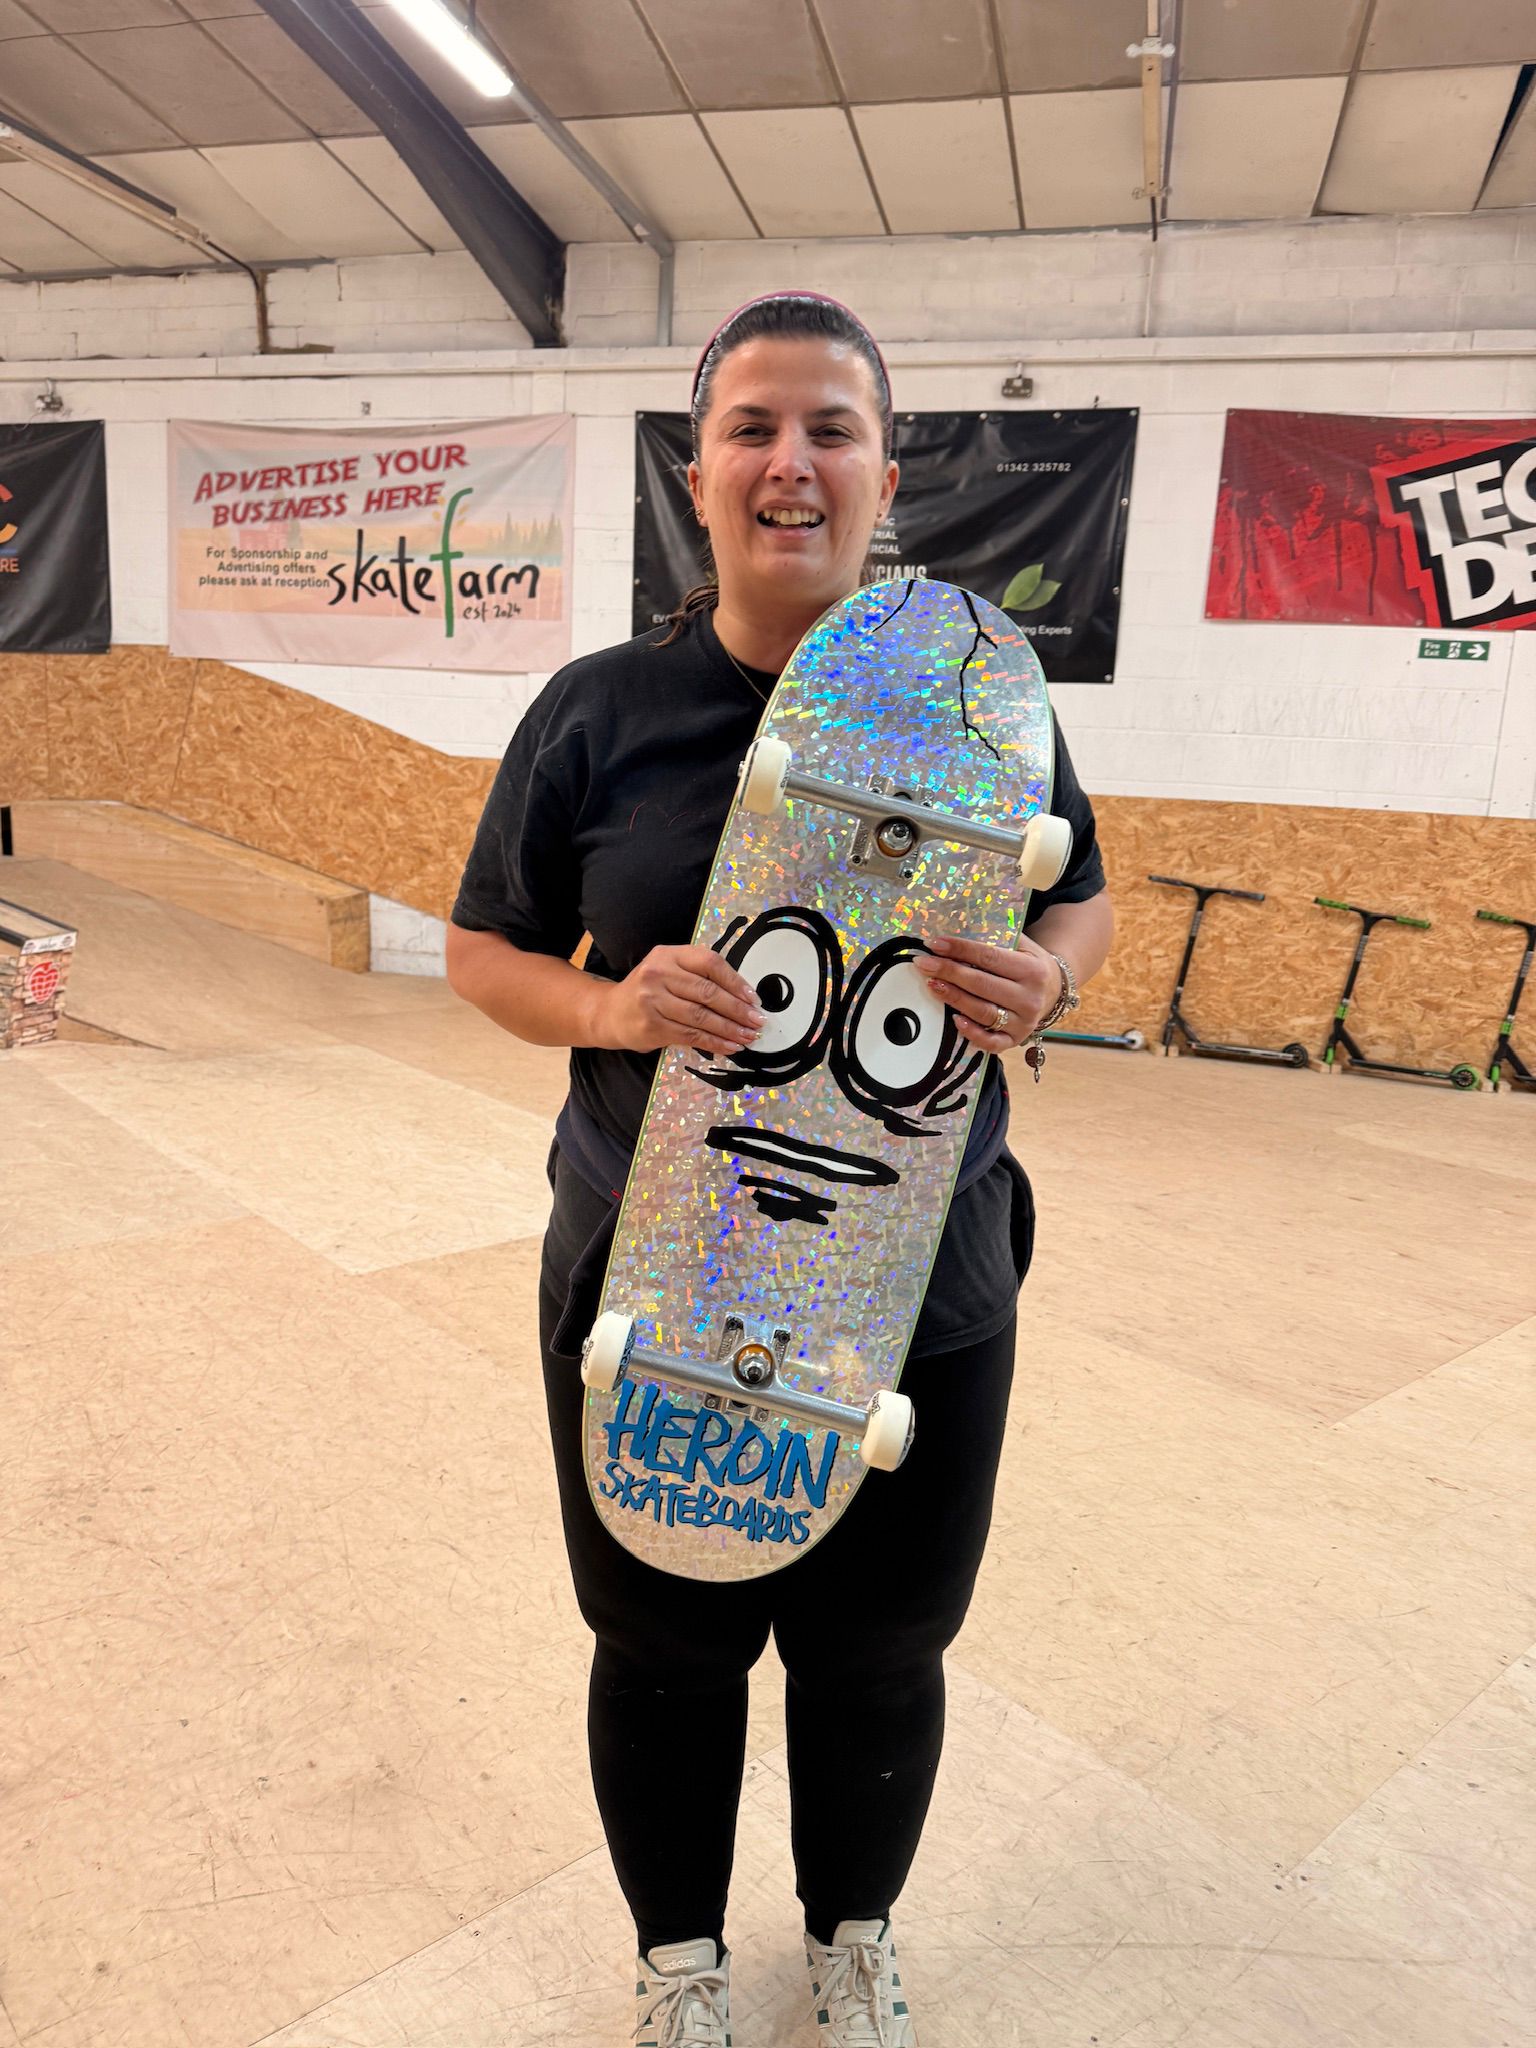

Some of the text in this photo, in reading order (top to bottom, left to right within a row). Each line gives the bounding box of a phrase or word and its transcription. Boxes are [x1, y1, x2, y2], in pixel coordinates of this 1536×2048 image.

[194, 443, 469, 504] ADVERTISE YOUR
[996, 462, 1072, 472] 01342 325782
[212, 480, 445, 528] BUSINESS HERE
[206, 546, 328, 560] For Sponsorship and
[869, 544, 901, 555] RCIAL
[217, 562, 316, 575] Advertising offers
[874, 564, 927, 580] CIANS
[199, 575, 330, 589] please ask at reception
[463, 601, 489, 622] est
[1038, 625, 1072, 636] Experts
[603, 1379, 841, 1508] HEROIN
[600, 1462, 810, 1545] SKATEBOARDS
[663, 1957, 697, 1971] adidas
